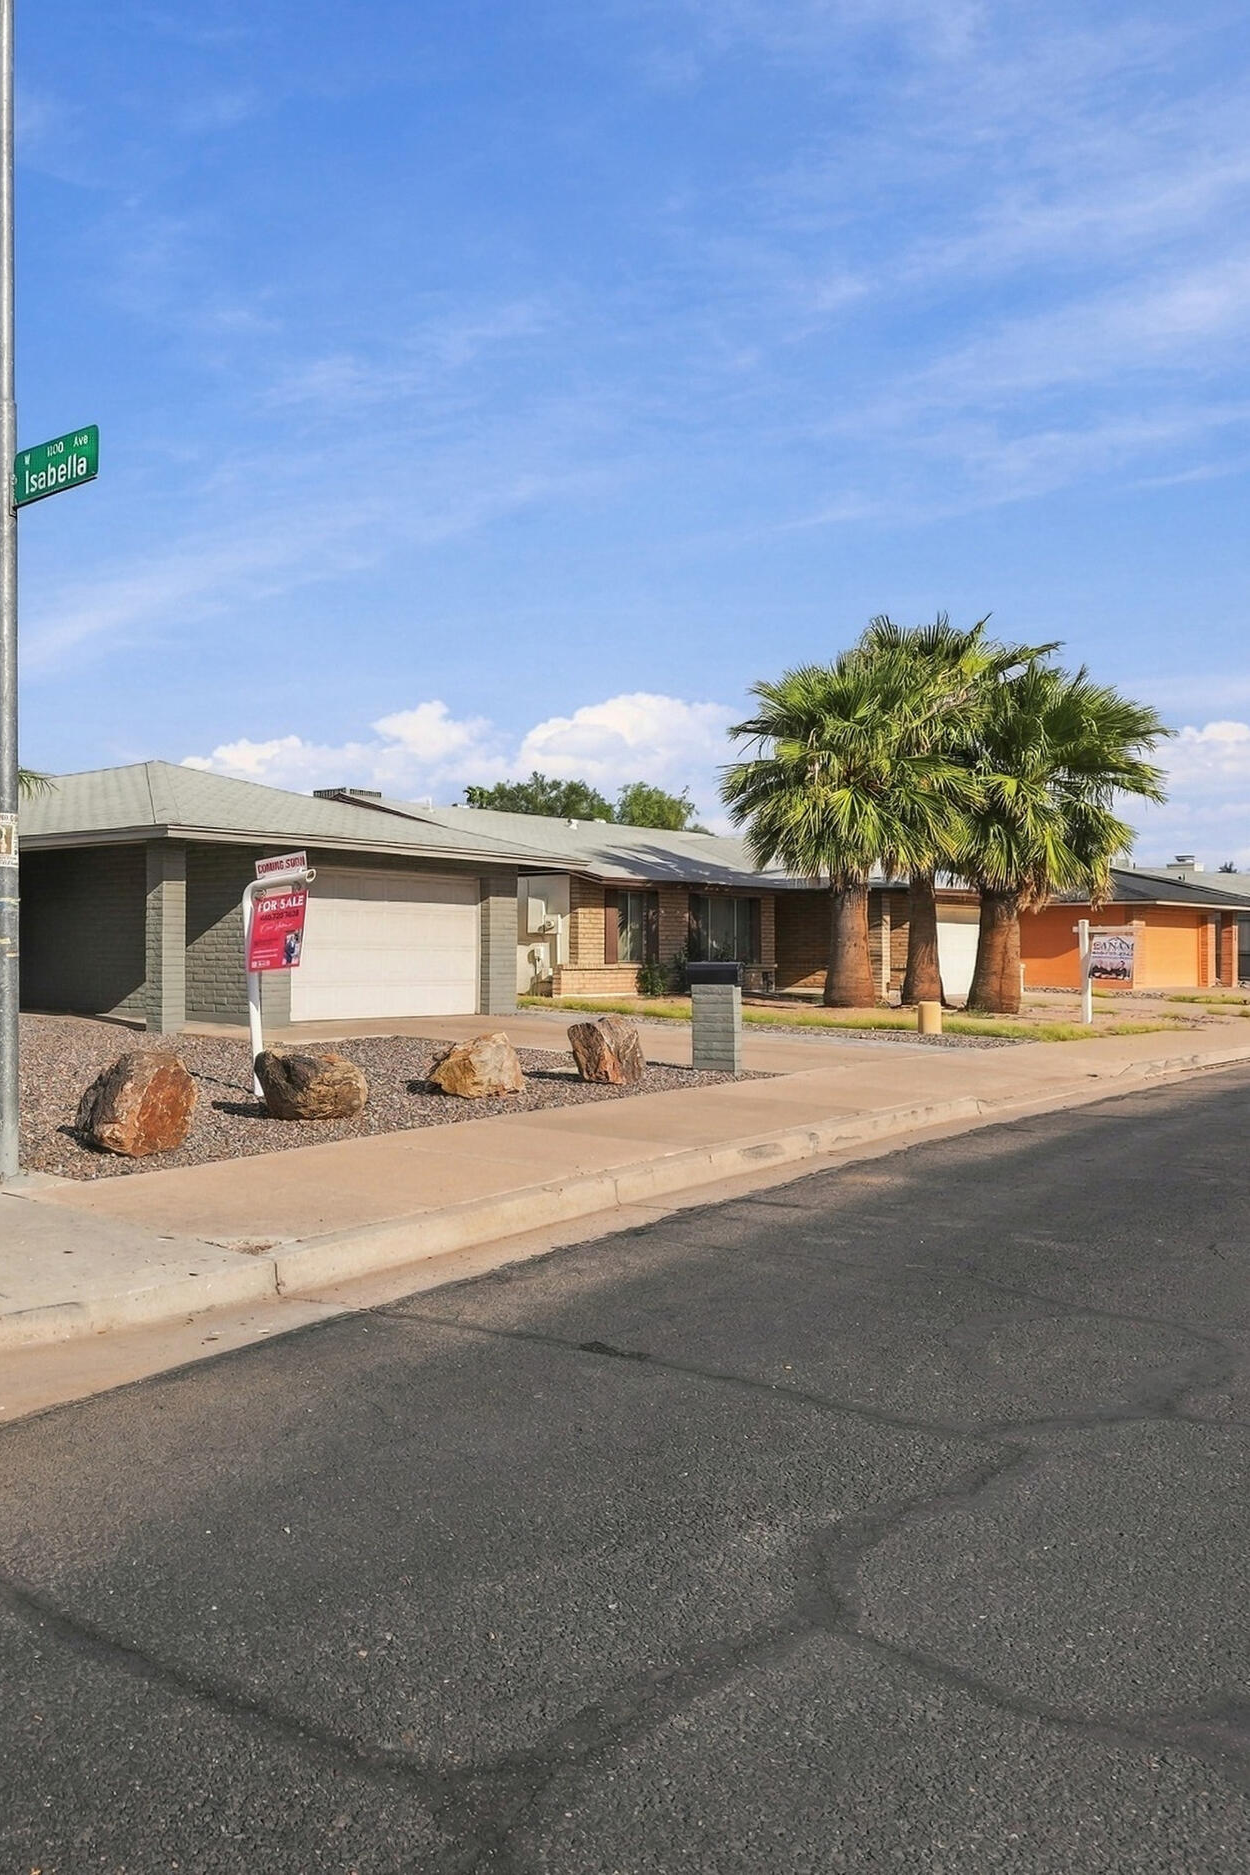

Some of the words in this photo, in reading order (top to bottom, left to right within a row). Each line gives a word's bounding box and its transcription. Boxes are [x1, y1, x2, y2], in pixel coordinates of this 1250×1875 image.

[24, 454, 30, 465] W
[73, 435, 89, 447] Ave
[25, 453, 87, 494] Isabella
[257, 861, 284, 874] COMING
[285, 856, 305, 868] SOON
[258, 900, 278, 912] FOR
[279, 895, 304, 909] SALE
